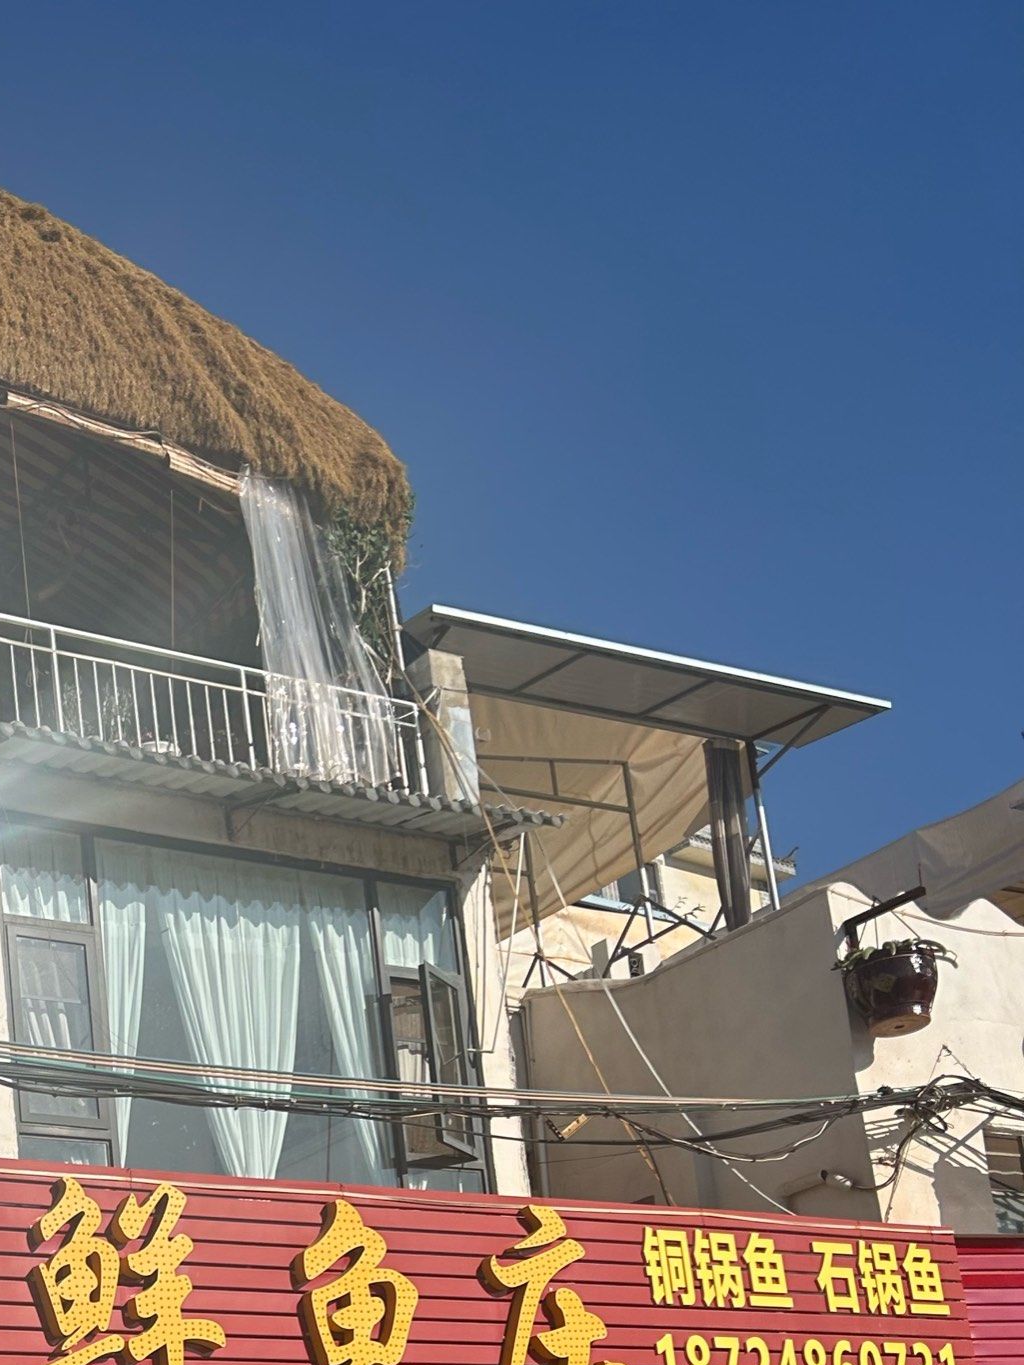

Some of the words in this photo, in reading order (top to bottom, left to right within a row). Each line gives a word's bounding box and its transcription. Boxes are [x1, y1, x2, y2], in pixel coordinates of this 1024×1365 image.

[642, 1225, 794, 1309] 铜锅鱼
[811, 1239, 951, 1316] 石锅鱼
